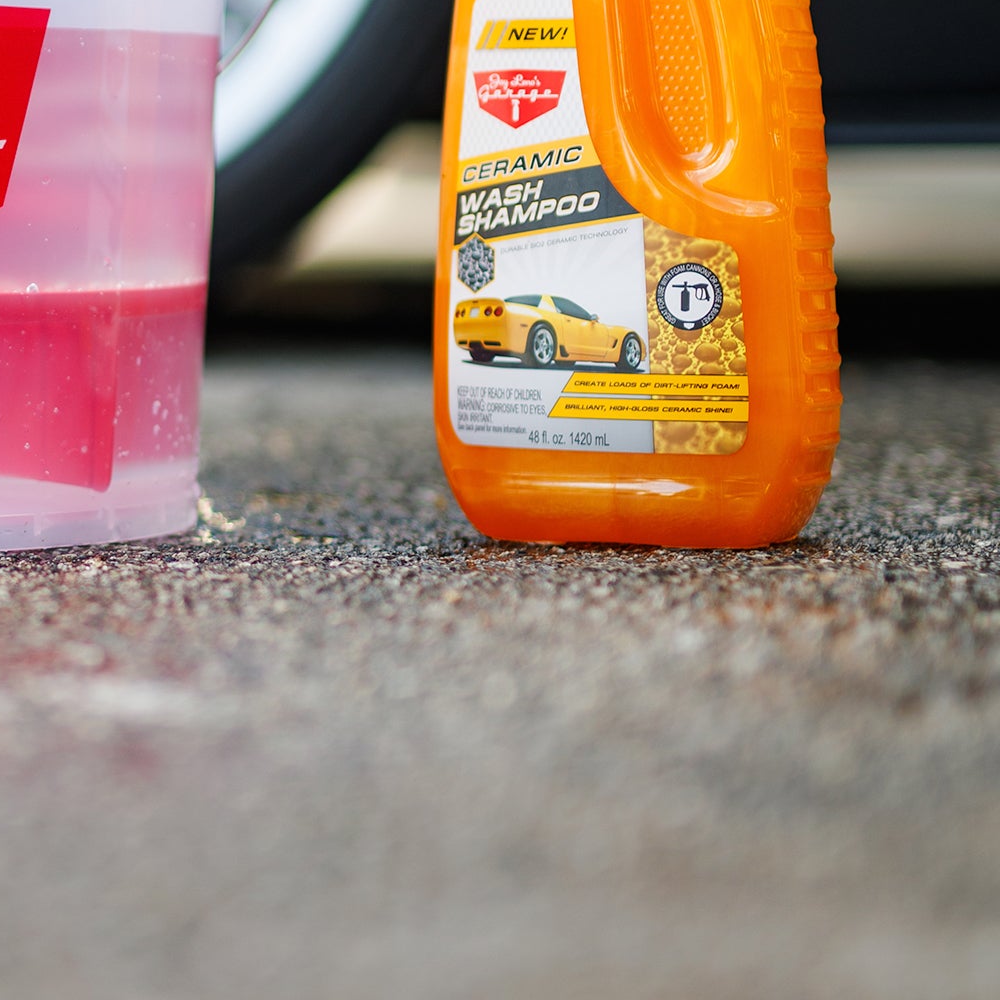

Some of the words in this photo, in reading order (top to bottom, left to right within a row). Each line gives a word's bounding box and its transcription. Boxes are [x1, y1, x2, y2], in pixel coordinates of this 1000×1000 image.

[508, 27, 568, 41] NEW!
[489, 73, 508, 90] Jay
[510, 74, 541, 86] Leno's
[479, 84, 559, 103] Garage
[463, 145, 583, 183] CERAMIC
[460, 179, 544, 215] WASH
[457, 191, 601, 237] SHAMPOO
[546, 235, 578, 246] CERAMIC
[579, 227, 630, 242] TECHNOLOGY
[660, 272, 673, 286] WITH
[669, 264, 685, 276] FOAM
[685, 264, 711, 277] CANNONS
[470, 387, 480, 397] OUT
[480, 387, 487, 397] OF
[488, 387, 505, 399] REACH
[506, 388, 513, 399] OF
[487, 402, 519, 414] CORROSIVE
[520, 404, 528, 414] TO
[565, 403, 606, 411] BRILLIANT,
[528, 430, 539, 443] 48
[542, 430, 550, 444] fl.
[553, 434, 566, 445] oz.
[570, 432, 592, 446] 1420
[595, 433, 610, 446] mL
